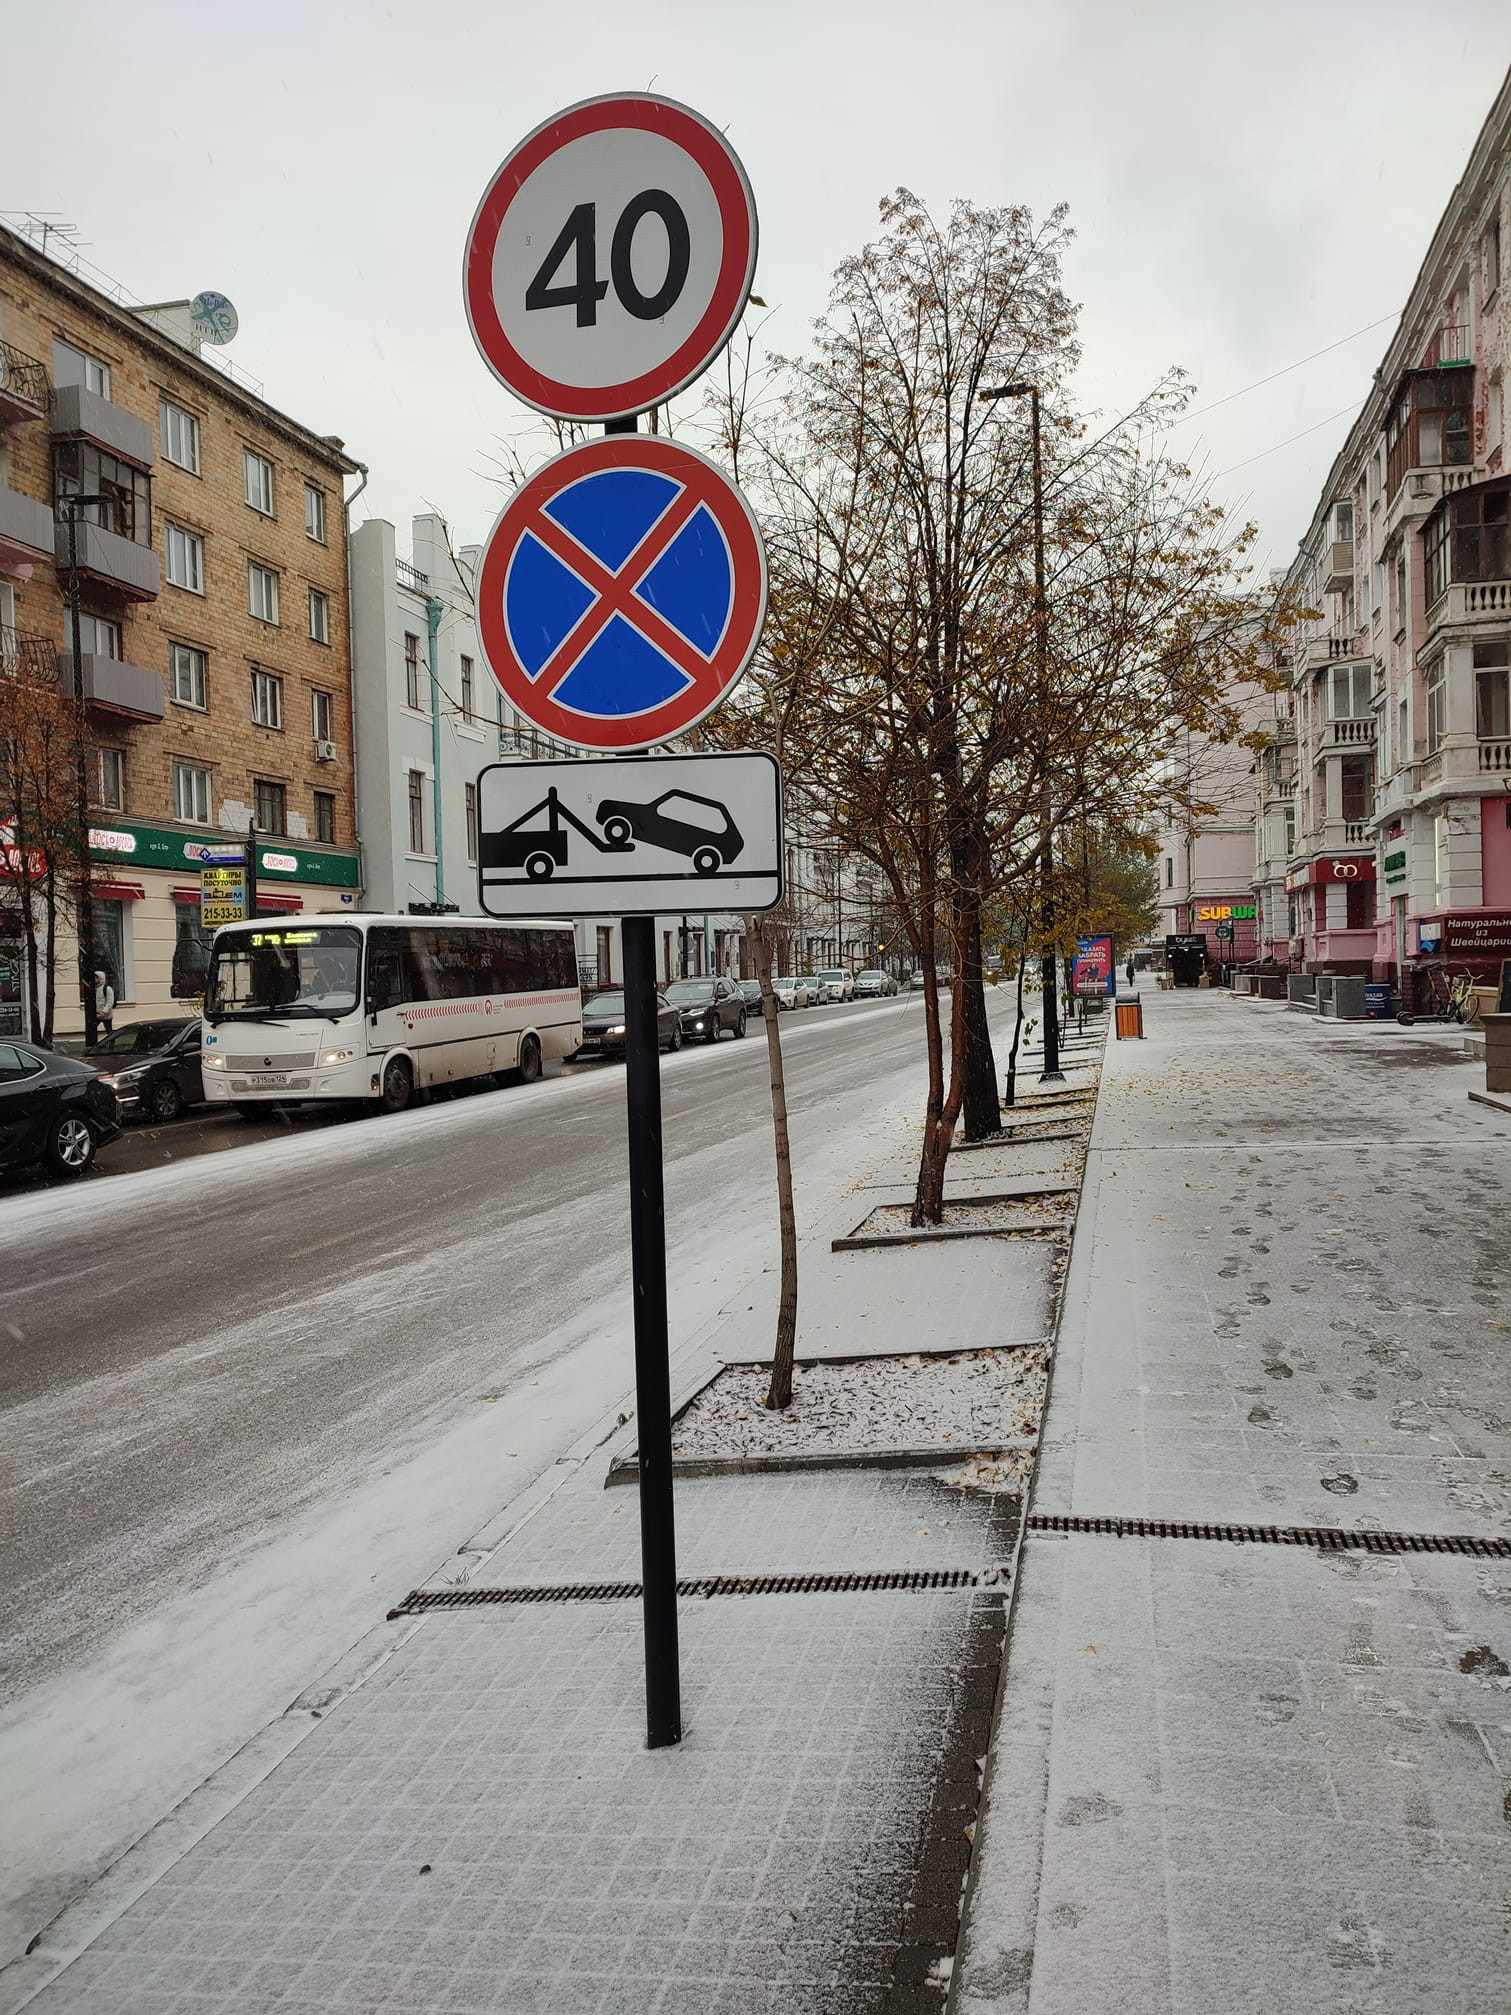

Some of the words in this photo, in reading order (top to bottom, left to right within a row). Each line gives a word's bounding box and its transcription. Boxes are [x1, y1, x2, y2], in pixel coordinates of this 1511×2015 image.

[526, 188, 691, 328] 40
[204, 907, 242, 919] 215-33-33
[1198, 905, 1257, 921] SUBWA
[1475, 929, 1489, 937] из
